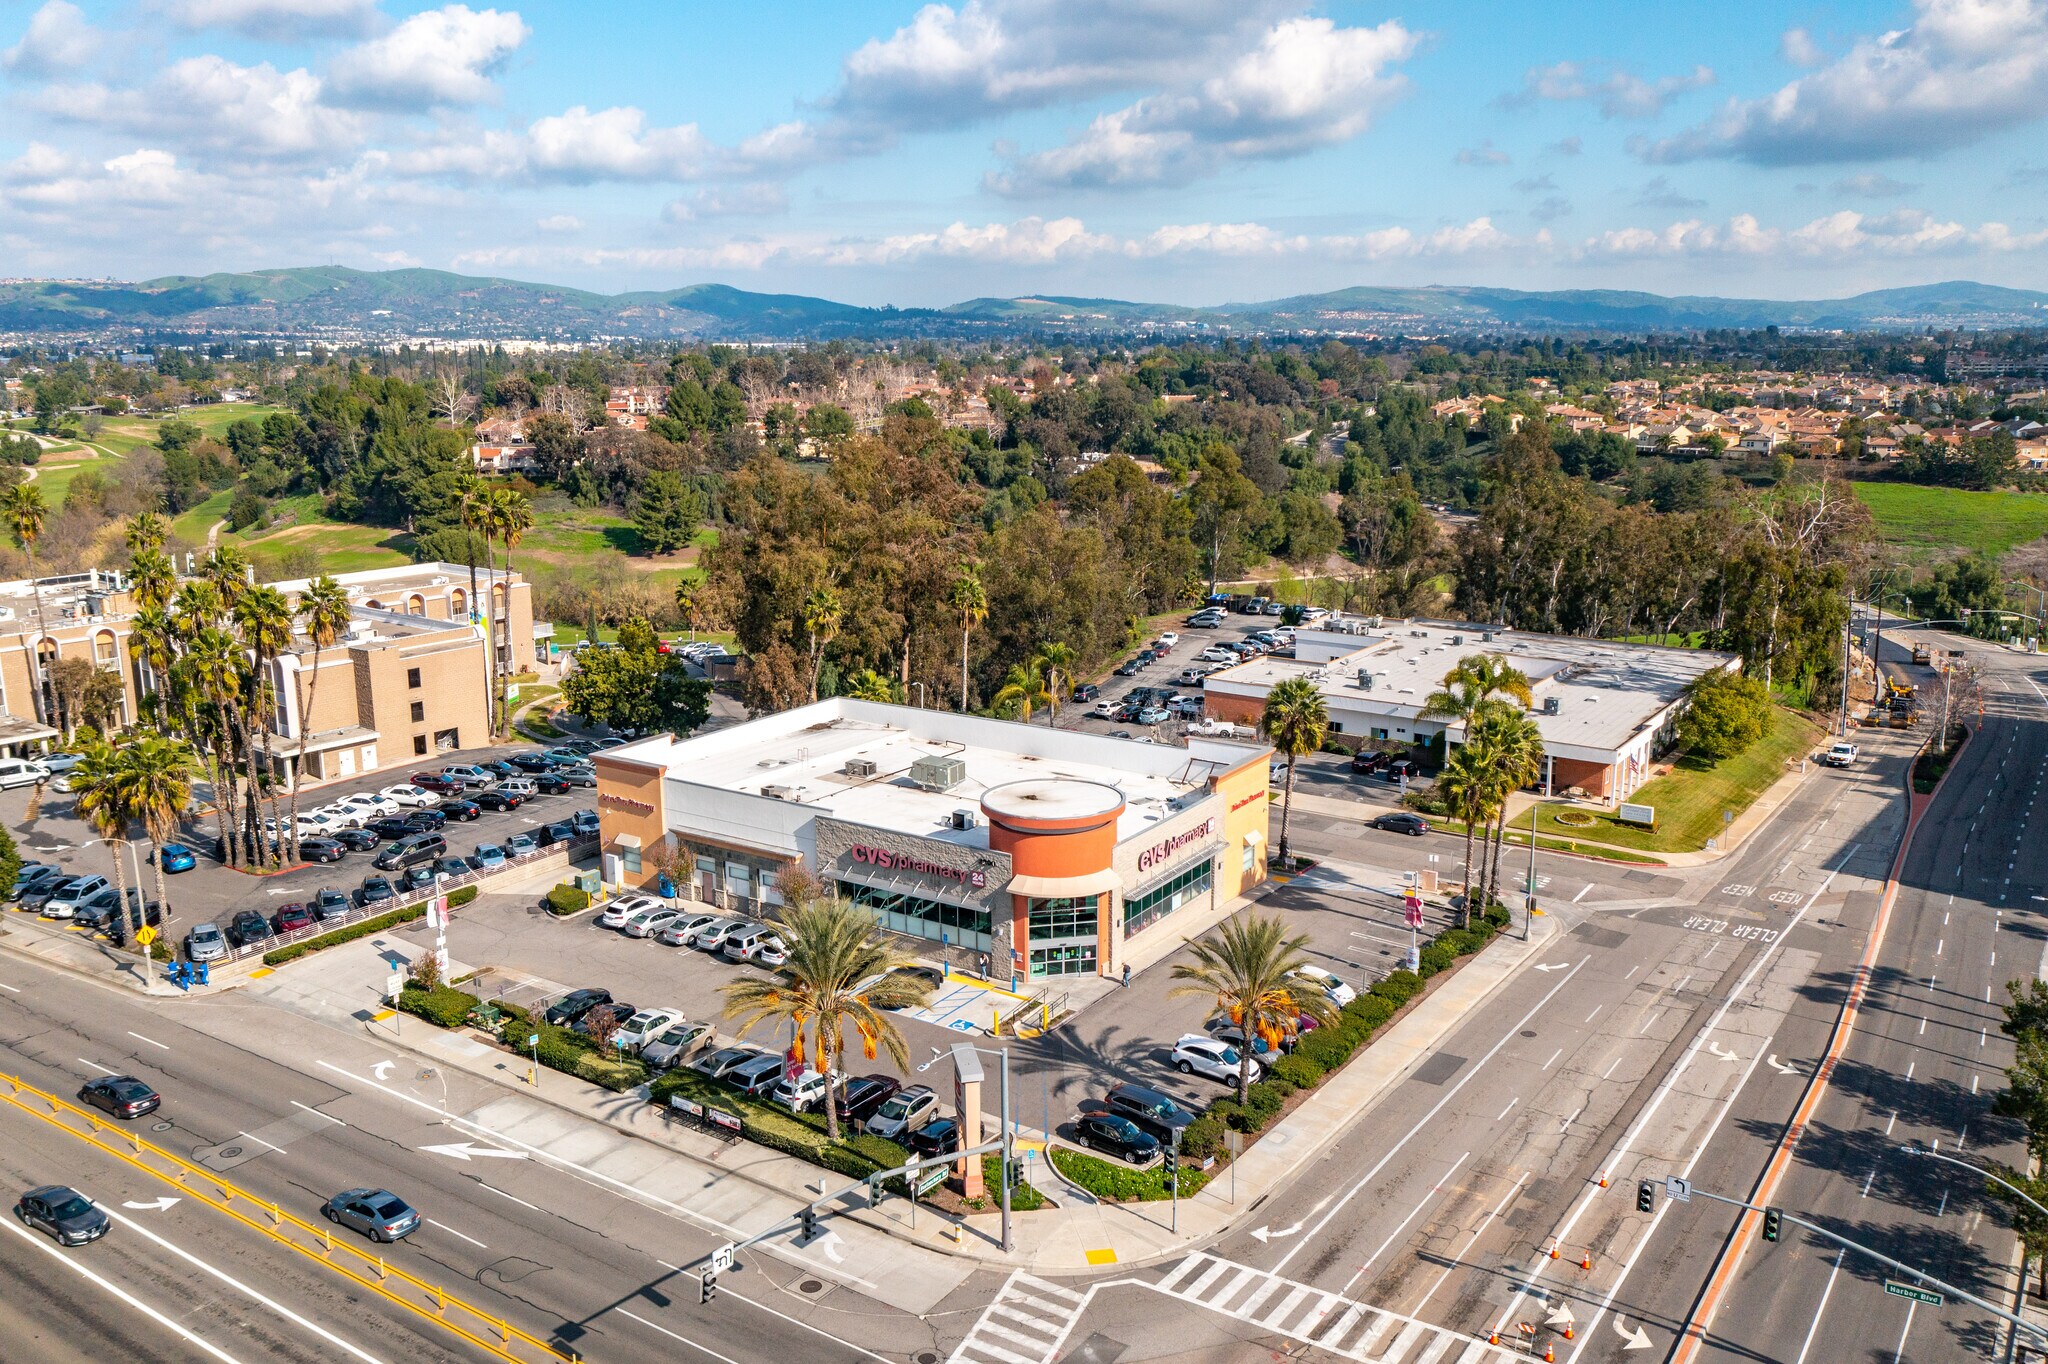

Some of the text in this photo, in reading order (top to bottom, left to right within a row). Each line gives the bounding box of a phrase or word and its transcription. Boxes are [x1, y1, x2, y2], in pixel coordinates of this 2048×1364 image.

[851, 843, 967, 884] CVS/pharmacy
[972, 872, 984, 882] 24
[1721, 883, 1758, 898] KEEP
[1768, 890, 1804, 905] KEEP
[1683, 915, 1729, 934] CLEAR
[1732, 924, 1779, 943] CLEAR
[1889, 1285, 1938, 1303] Harbor Blvd
